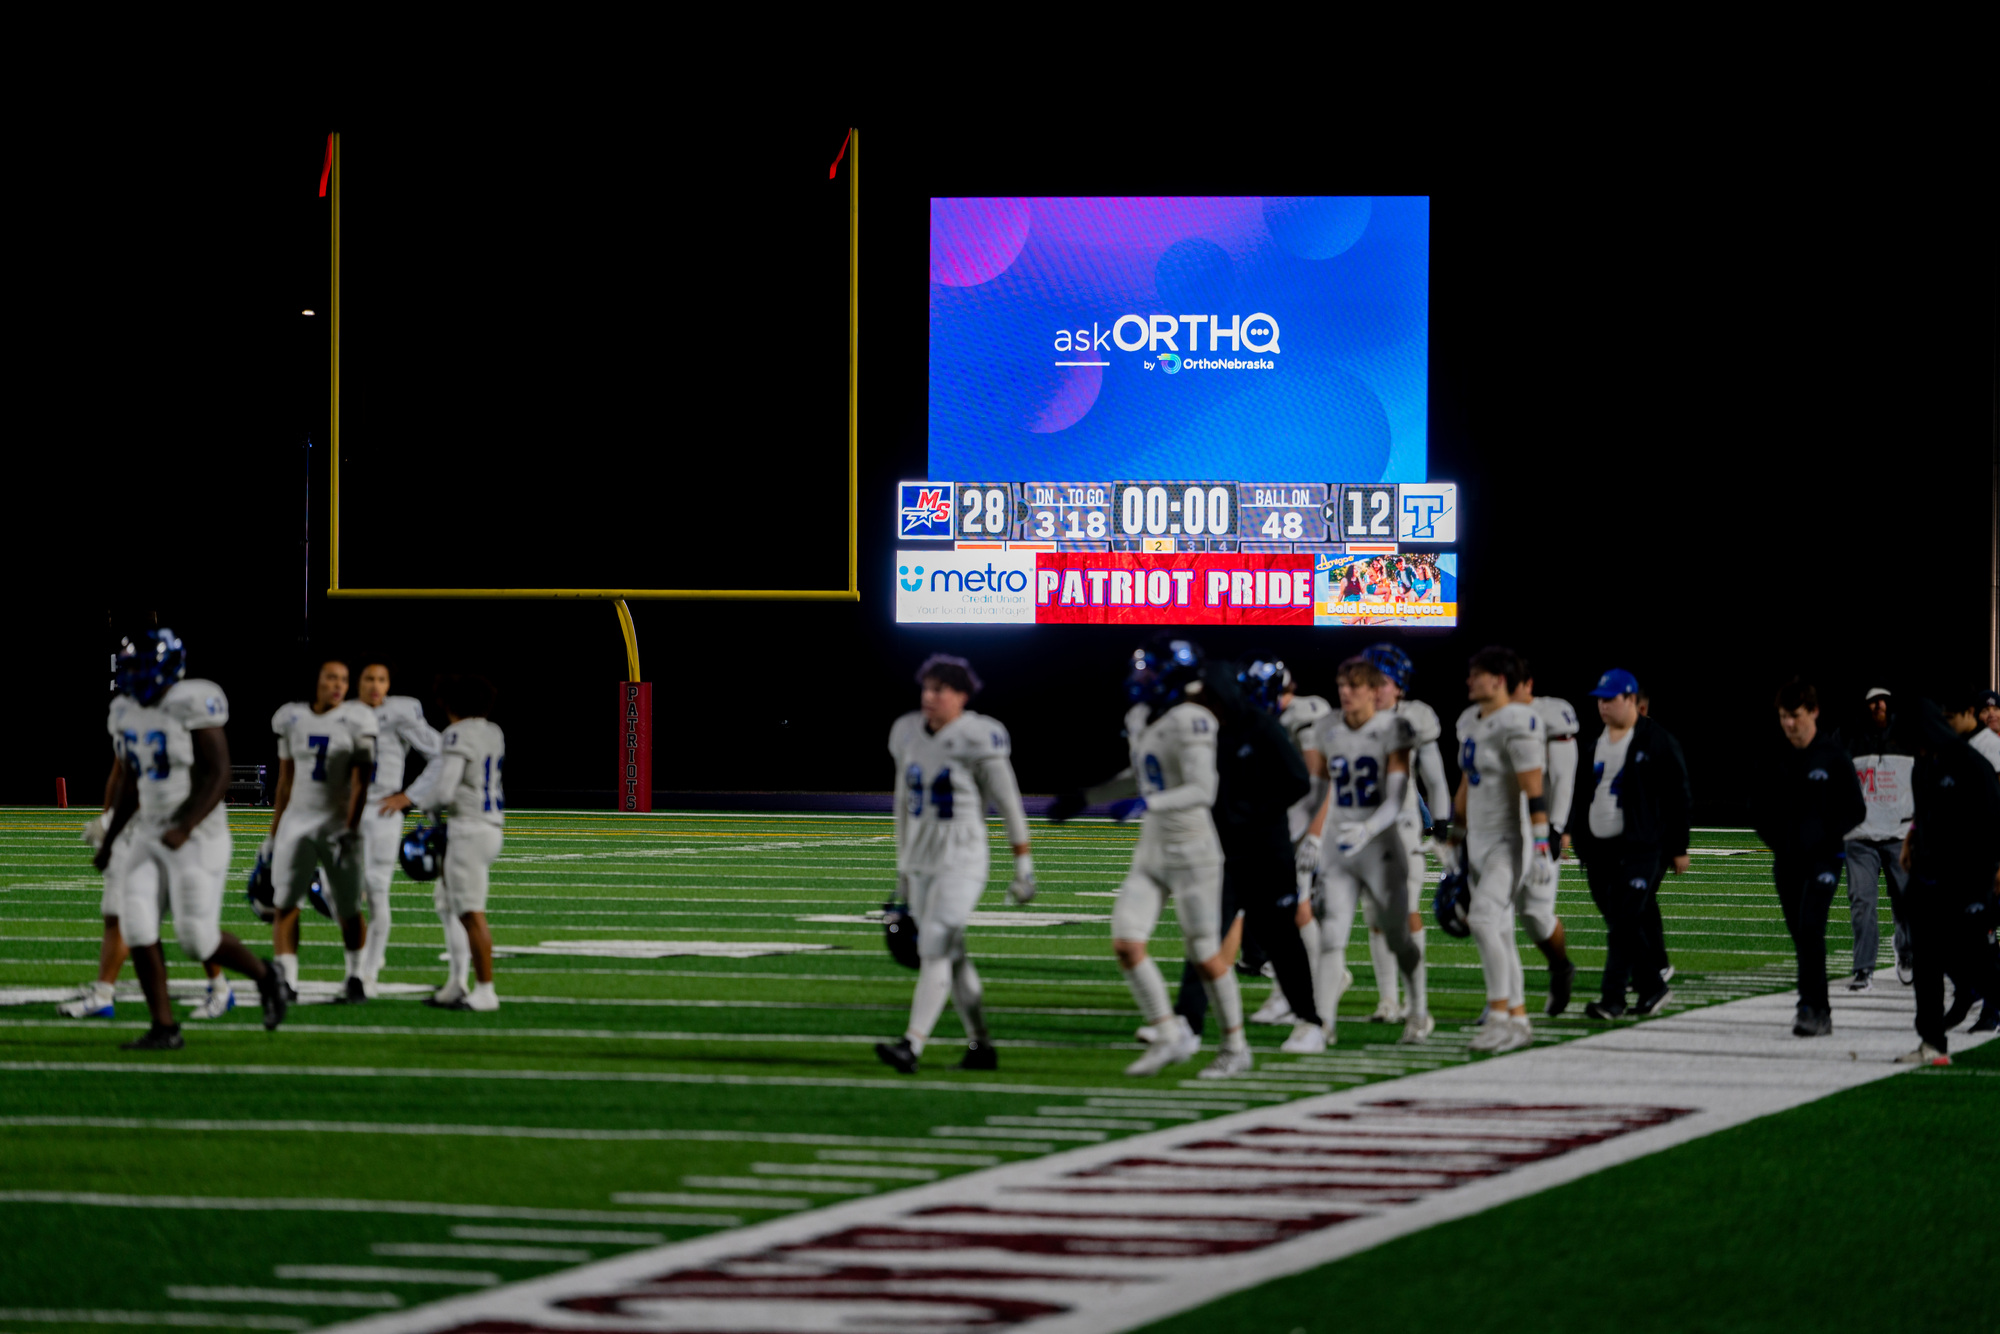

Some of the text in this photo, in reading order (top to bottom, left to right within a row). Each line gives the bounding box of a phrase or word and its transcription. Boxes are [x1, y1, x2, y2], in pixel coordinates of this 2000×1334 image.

[1144, 358, 1274, 371] by OrthoNebraska
[1036, 489, 1054, 505] DN
[1067, 489, 1104, 505] TO GO
[1255, 490, 1310, 505] BALL ON
[963, 489, 1005, 533] 28
[1122, 487, 1229, 535] 00:00
[1348, 491, 1390, 535] 12
[1403, 495, 1444, 538] T
[1035, 511, 1055, 538] 3
[1065, 511, 1106, 538] 18
[1261, 512, 1303, 538] 48
[1122, 540, 1129, 551] 1
[1154, 541, 1162, 551] 2
[1187, 541, 1195, 551] 3
[1218, 541, 1227, 551] 4
[931, 563, 1027, 592] metro
[1036, 569, 1311, 606] PATRIOT PRIDE
[961, 594, 1026, 603] Credit Union
[1327, 603, 1444, 615] Bold Fresh Flavors
[308, 734, 330, 781] 7
[626, 687, 638, 809] PATRIOTS
[1330, 755, 1381, 807] 22
